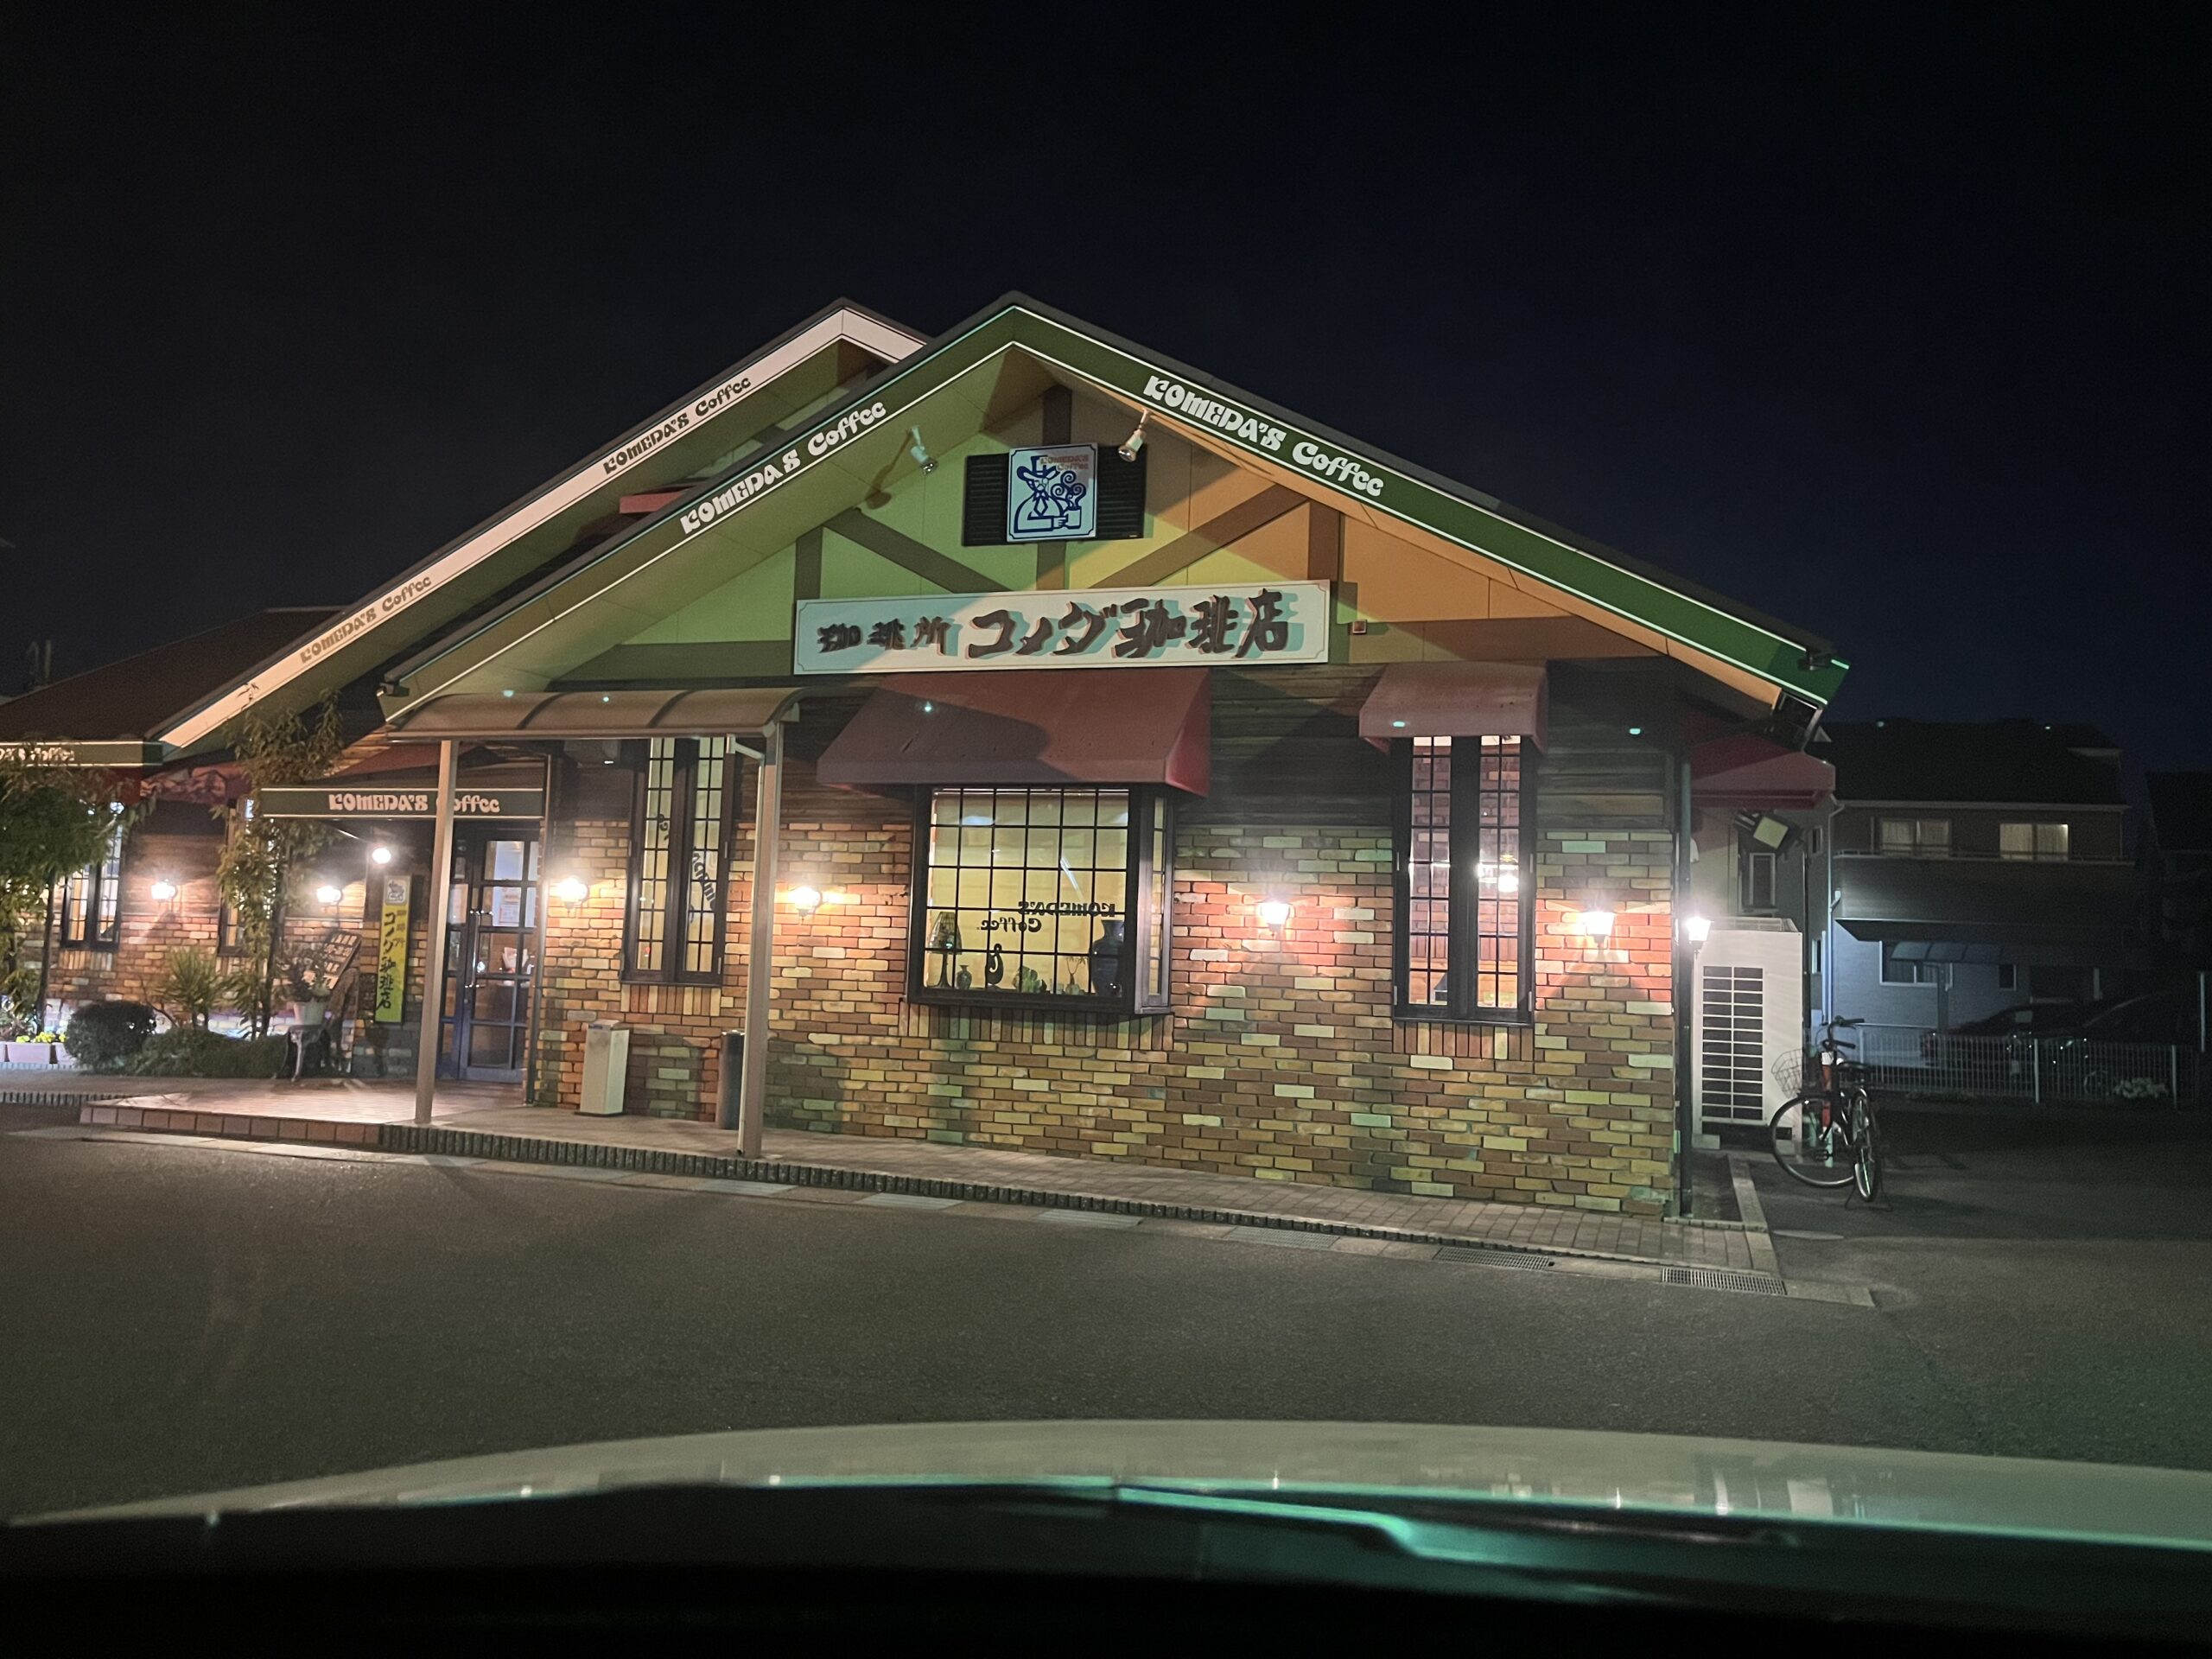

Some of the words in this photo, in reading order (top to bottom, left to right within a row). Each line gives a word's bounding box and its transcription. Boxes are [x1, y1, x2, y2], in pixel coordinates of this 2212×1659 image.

[603, 412, 690, 474] KOMEDA'S
[695, 378, 752, 416] Coffee
[807, 402, 887, 456] Coffee
[1143, 375, 1287, 451] KOMEDA'S
[1293, 442, 1383, 497] Coffee
[300, 607, 377, 664] KOMEDA'S
[382, 576, 432, 613] Coffee
[328, 793, 428, 811] KOMEDA'S
[435, 795, 500, 813] offee
